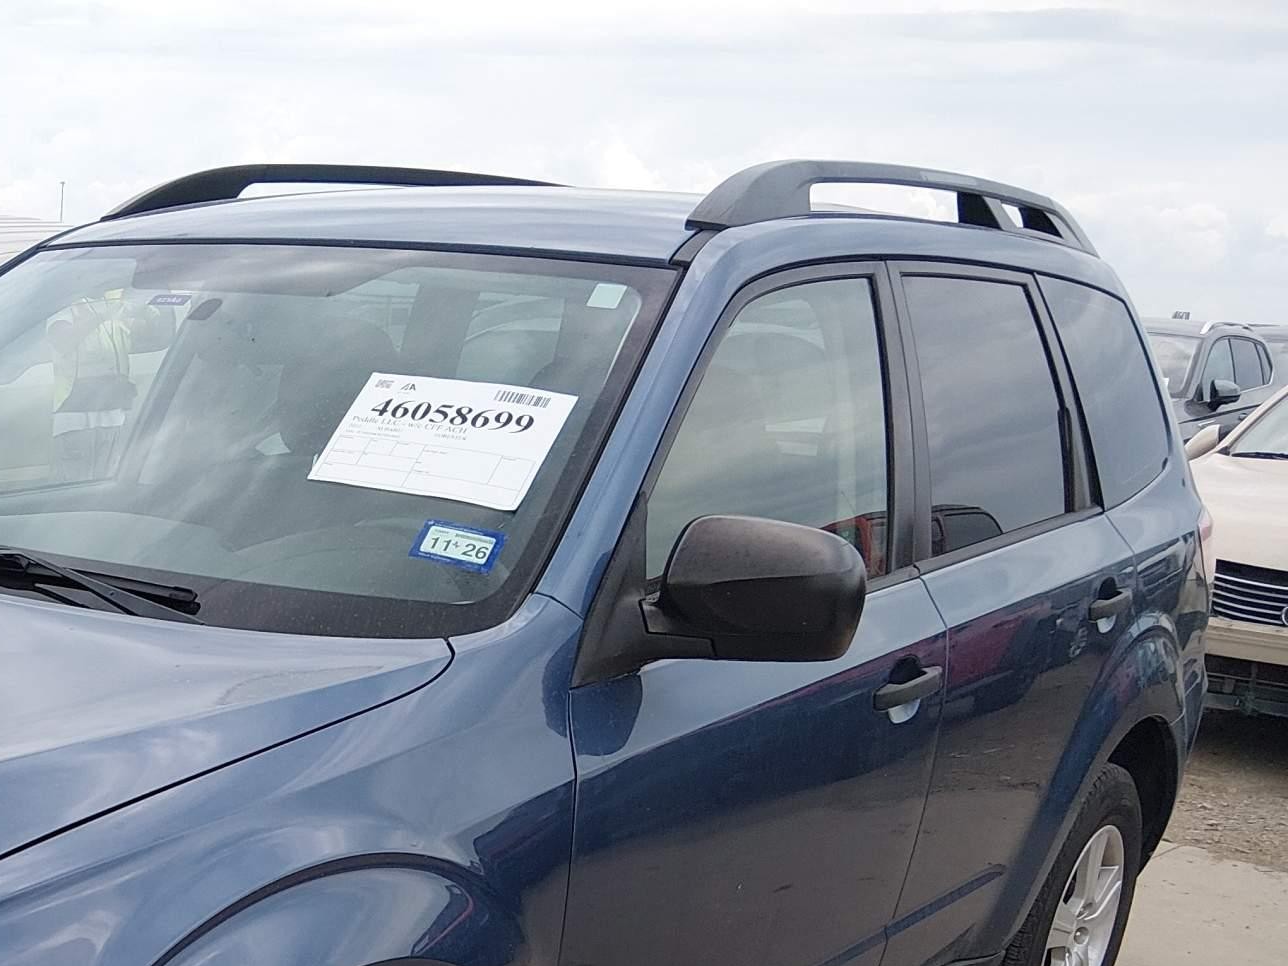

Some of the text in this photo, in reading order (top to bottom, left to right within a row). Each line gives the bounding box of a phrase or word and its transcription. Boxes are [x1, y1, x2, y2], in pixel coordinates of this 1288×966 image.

[370, 398, 535, 434] 46058699
[430, 535, 452, 552] 11
[461, 543, 489, 560] 26
